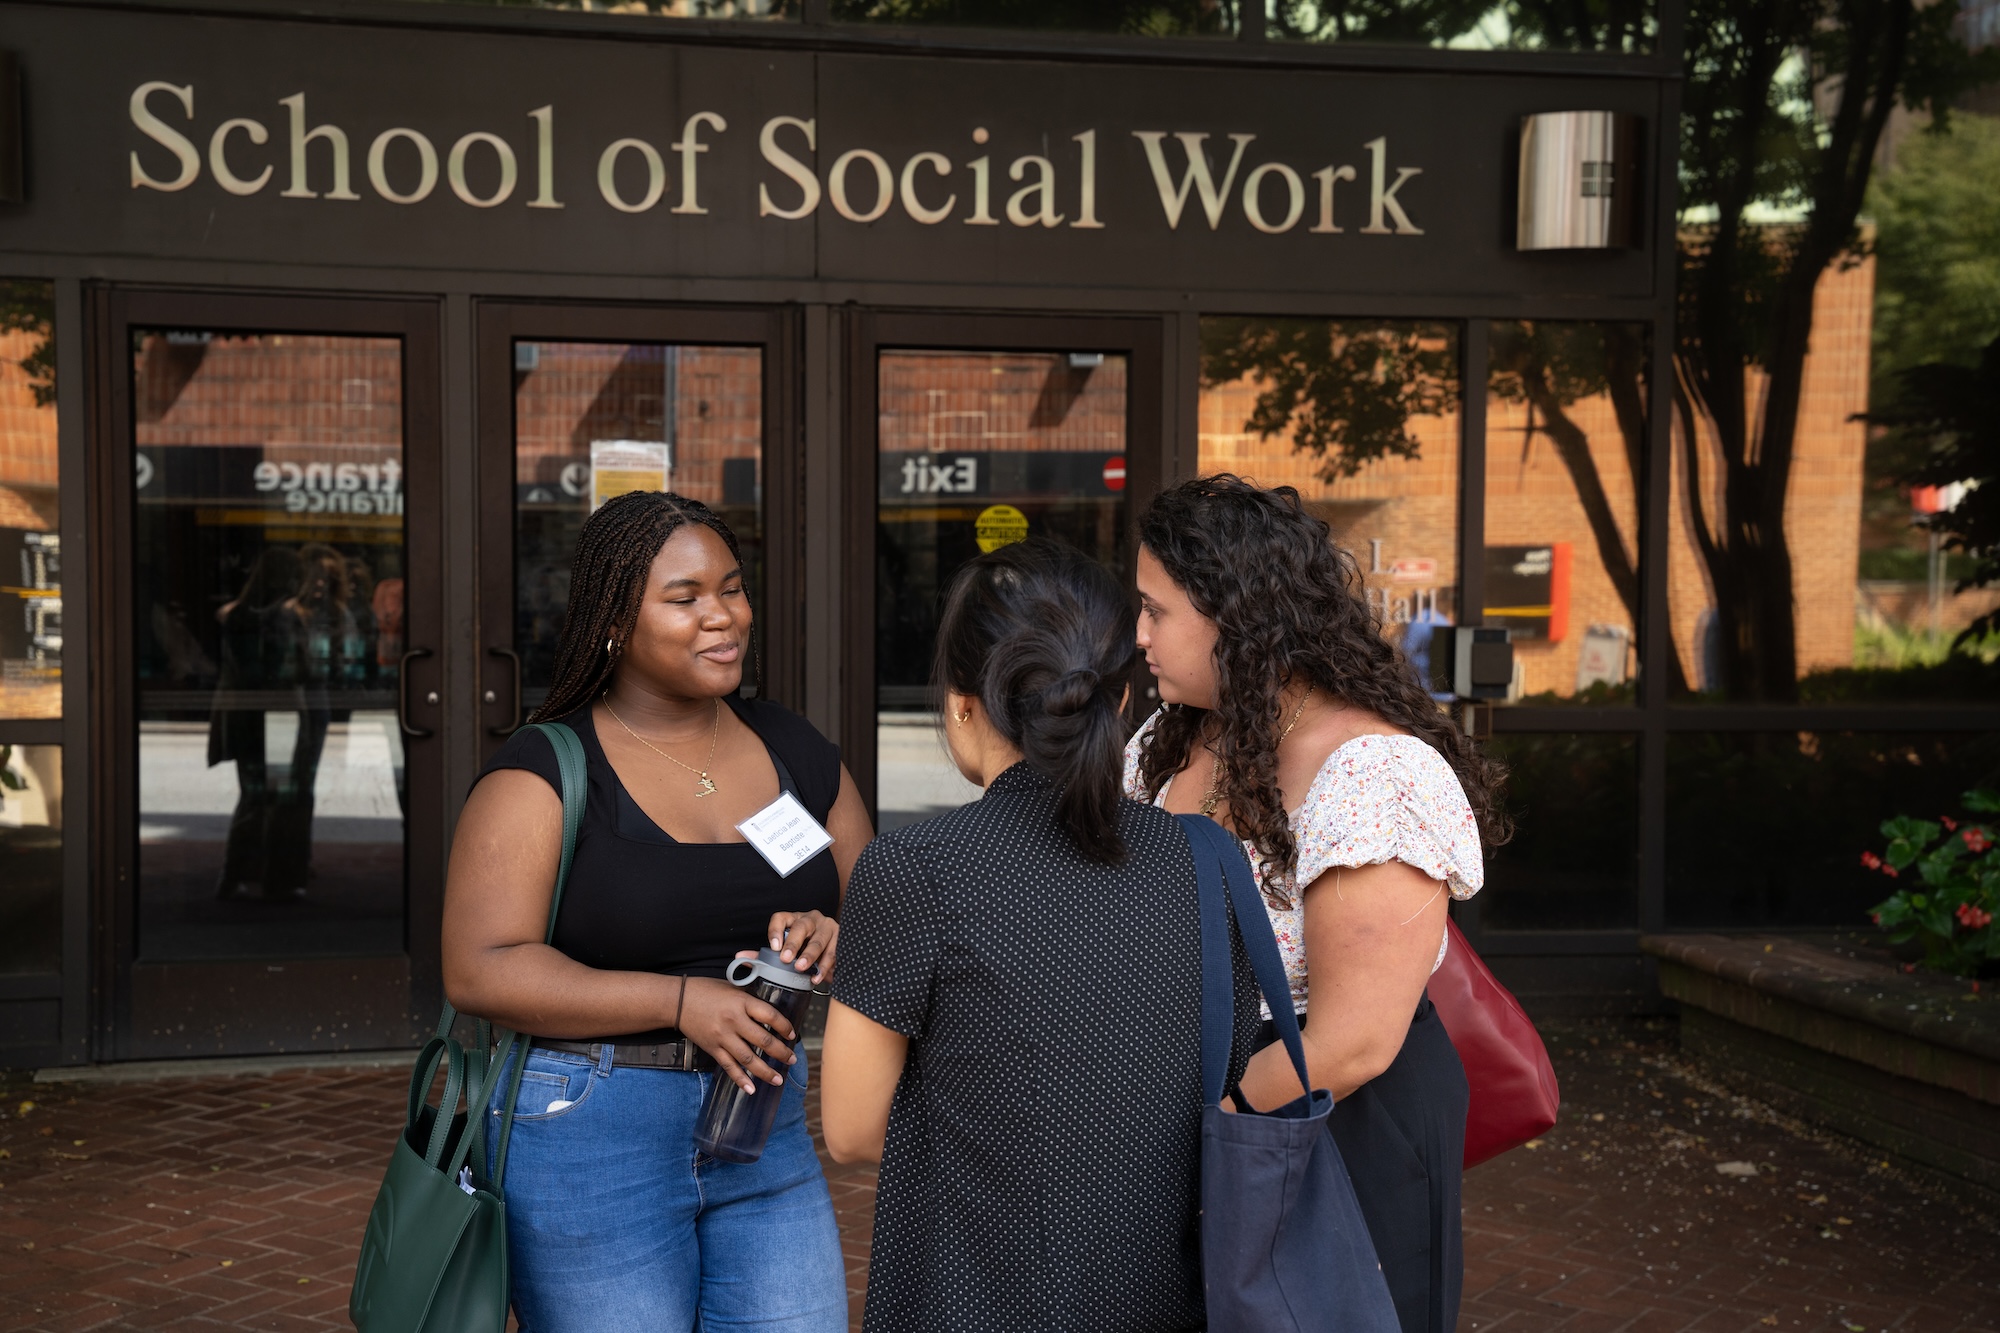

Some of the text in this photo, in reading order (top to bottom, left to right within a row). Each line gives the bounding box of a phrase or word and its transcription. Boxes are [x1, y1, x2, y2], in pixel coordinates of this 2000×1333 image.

[129, 81, 1424, 236] School of Social Work
[1366, 587, 1438, 625] Hall
[779, 831, 805, 852] Baptiste
[794, 845, 811, 860] 3E14
